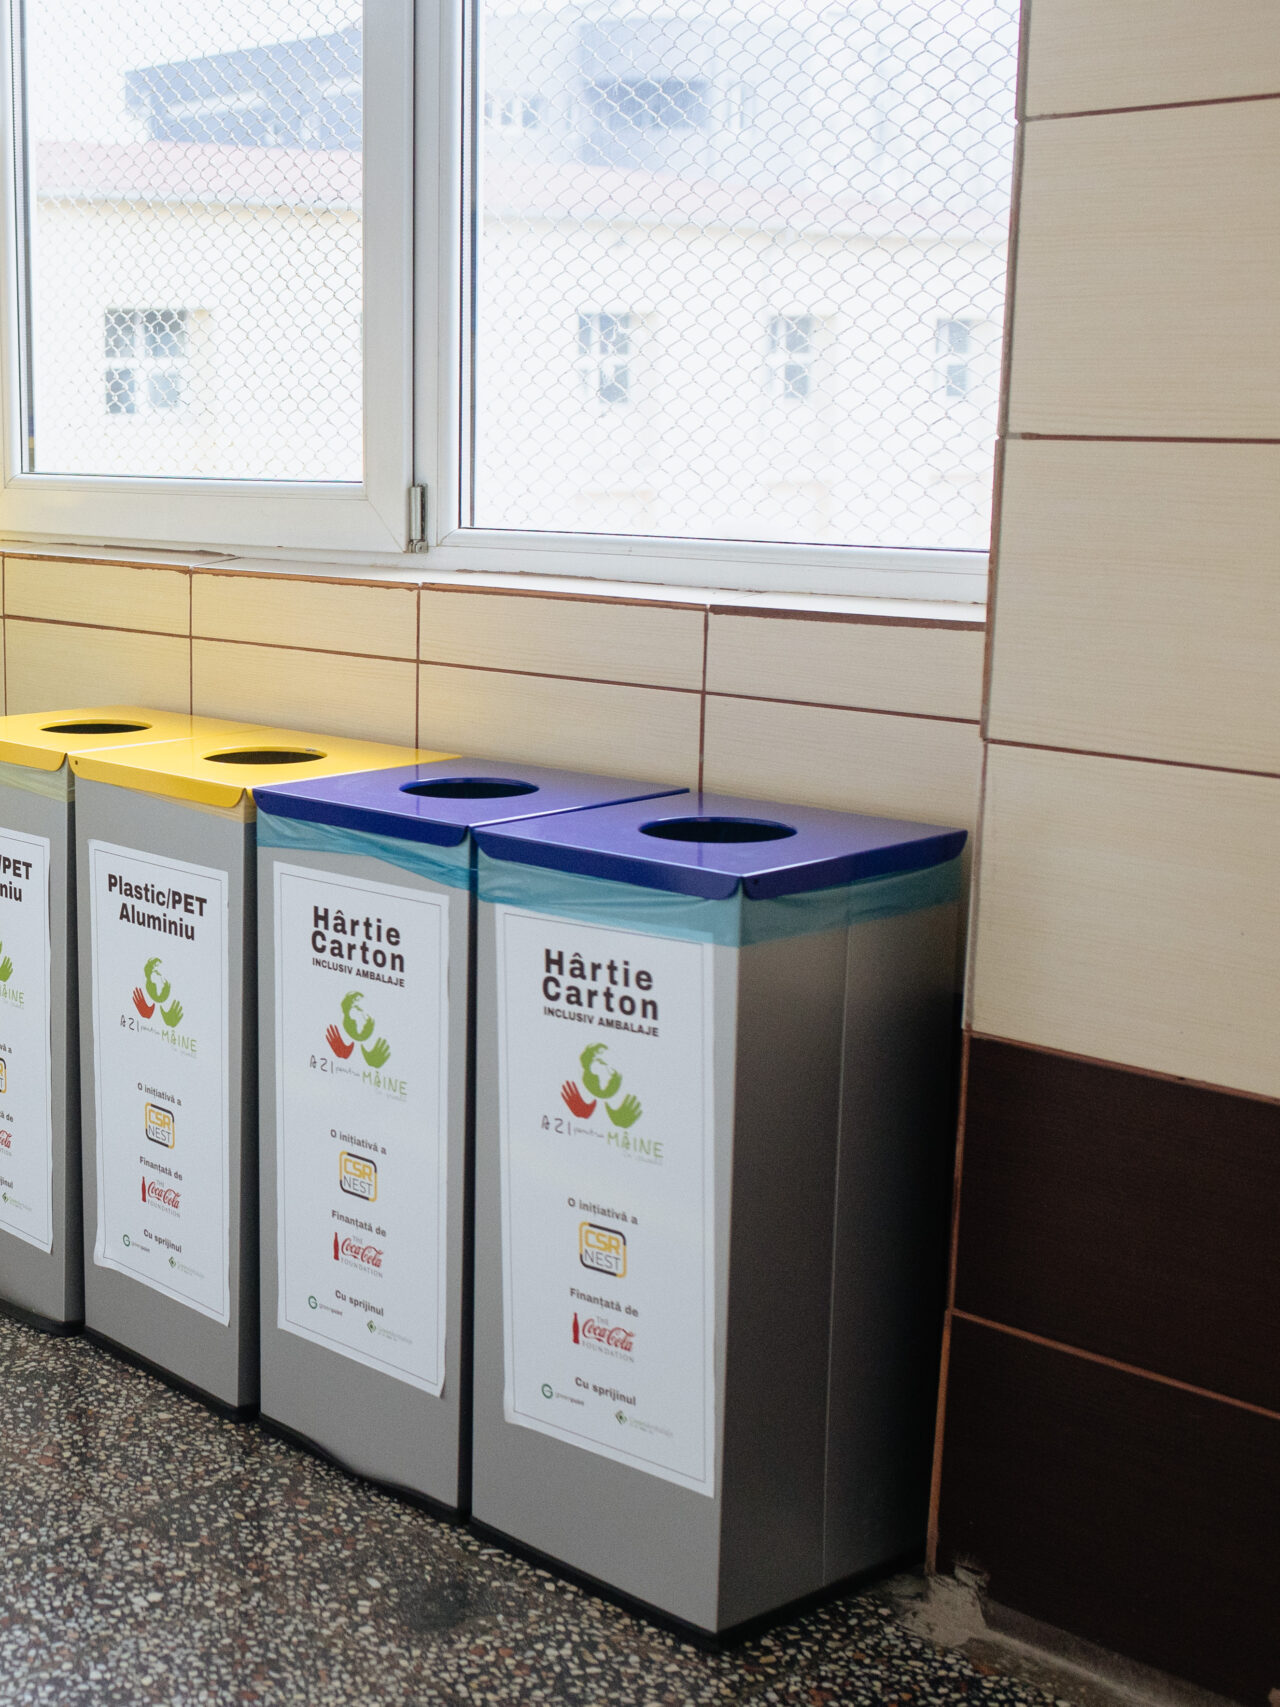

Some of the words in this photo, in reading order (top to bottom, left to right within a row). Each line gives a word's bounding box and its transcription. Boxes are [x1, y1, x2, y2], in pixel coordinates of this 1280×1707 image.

[108, 873, 207, 917] Plastic/PET
[119, 902, 195, 941] Aluminiu
[313, 905, 400, 946] Hârtie
[311, 930, 404, 973] Carton
[312, 957, 353, 974] INCLUSIV
[356, 968, 405, 988] AMBALAJE
[545, 948, 653, 991] Hârtie
[542, 976, 658, 1021] Carton
[543, 1006, 594, 1024] INCLUSIV
[598, 1017, 659, 1037] AMBALAJE
[137, 1082, 143, 1091] O
[6, 1113, 14, 1122] de
[149, 1109, 171, 1131] CSR
[149, 1124, 171, 1142] NEST
[330, 1129, 336, 1138] O
[174, 1171, 183, 1181] de
[344, 1158, 372, 1182] CSR
[343, 1175, 373, 1195] NEST
[568, 1197, 576, 1207] O
[144, 1229, 152, 1239] Cu
[154, 1235, 182, 1253] sprijinul
[375, 1225, 387, 1237] de
[585, 1229, 620, 1255] CSR
[340, 1257, 383, 1279] FOUNDATION
[584, 1249, 621, 1271] NEST
[335, 1290, 346, 1301] Cu
[349, 1296, 384, 1317] sprijinul
[625, 1305, 639, 1317] de
[575, 1377, 589, 1389] Cu
[592, 1384, 636, 1406] sprijinul
